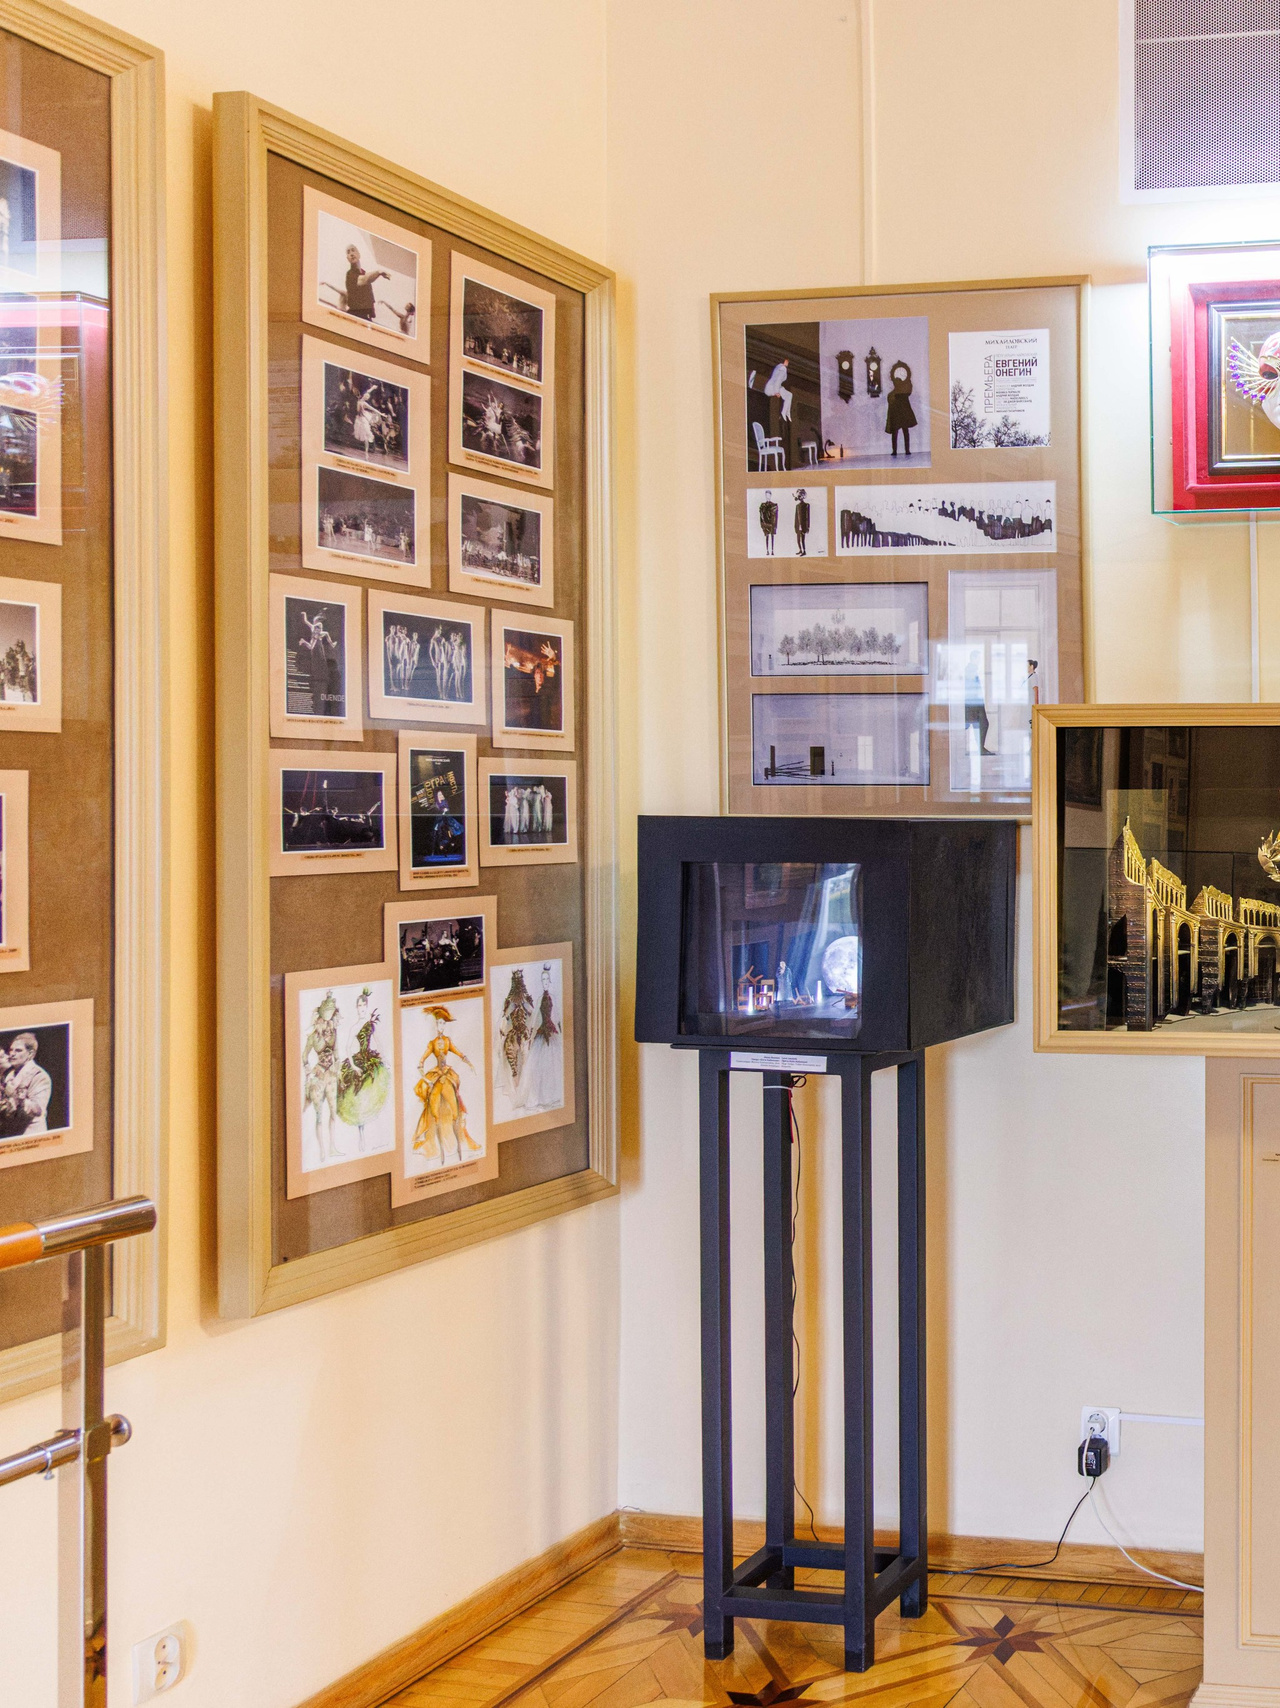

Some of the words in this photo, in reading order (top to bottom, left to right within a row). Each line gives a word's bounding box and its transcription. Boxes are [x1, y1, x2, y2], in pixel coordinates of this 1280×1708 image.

[995, 357, 1038, 368] ЕВГЕНИЙ
[995, 368, 1032, 377] ОНЕГИН
[984, 354, 994, 414] ПРЕМЬЕРА
